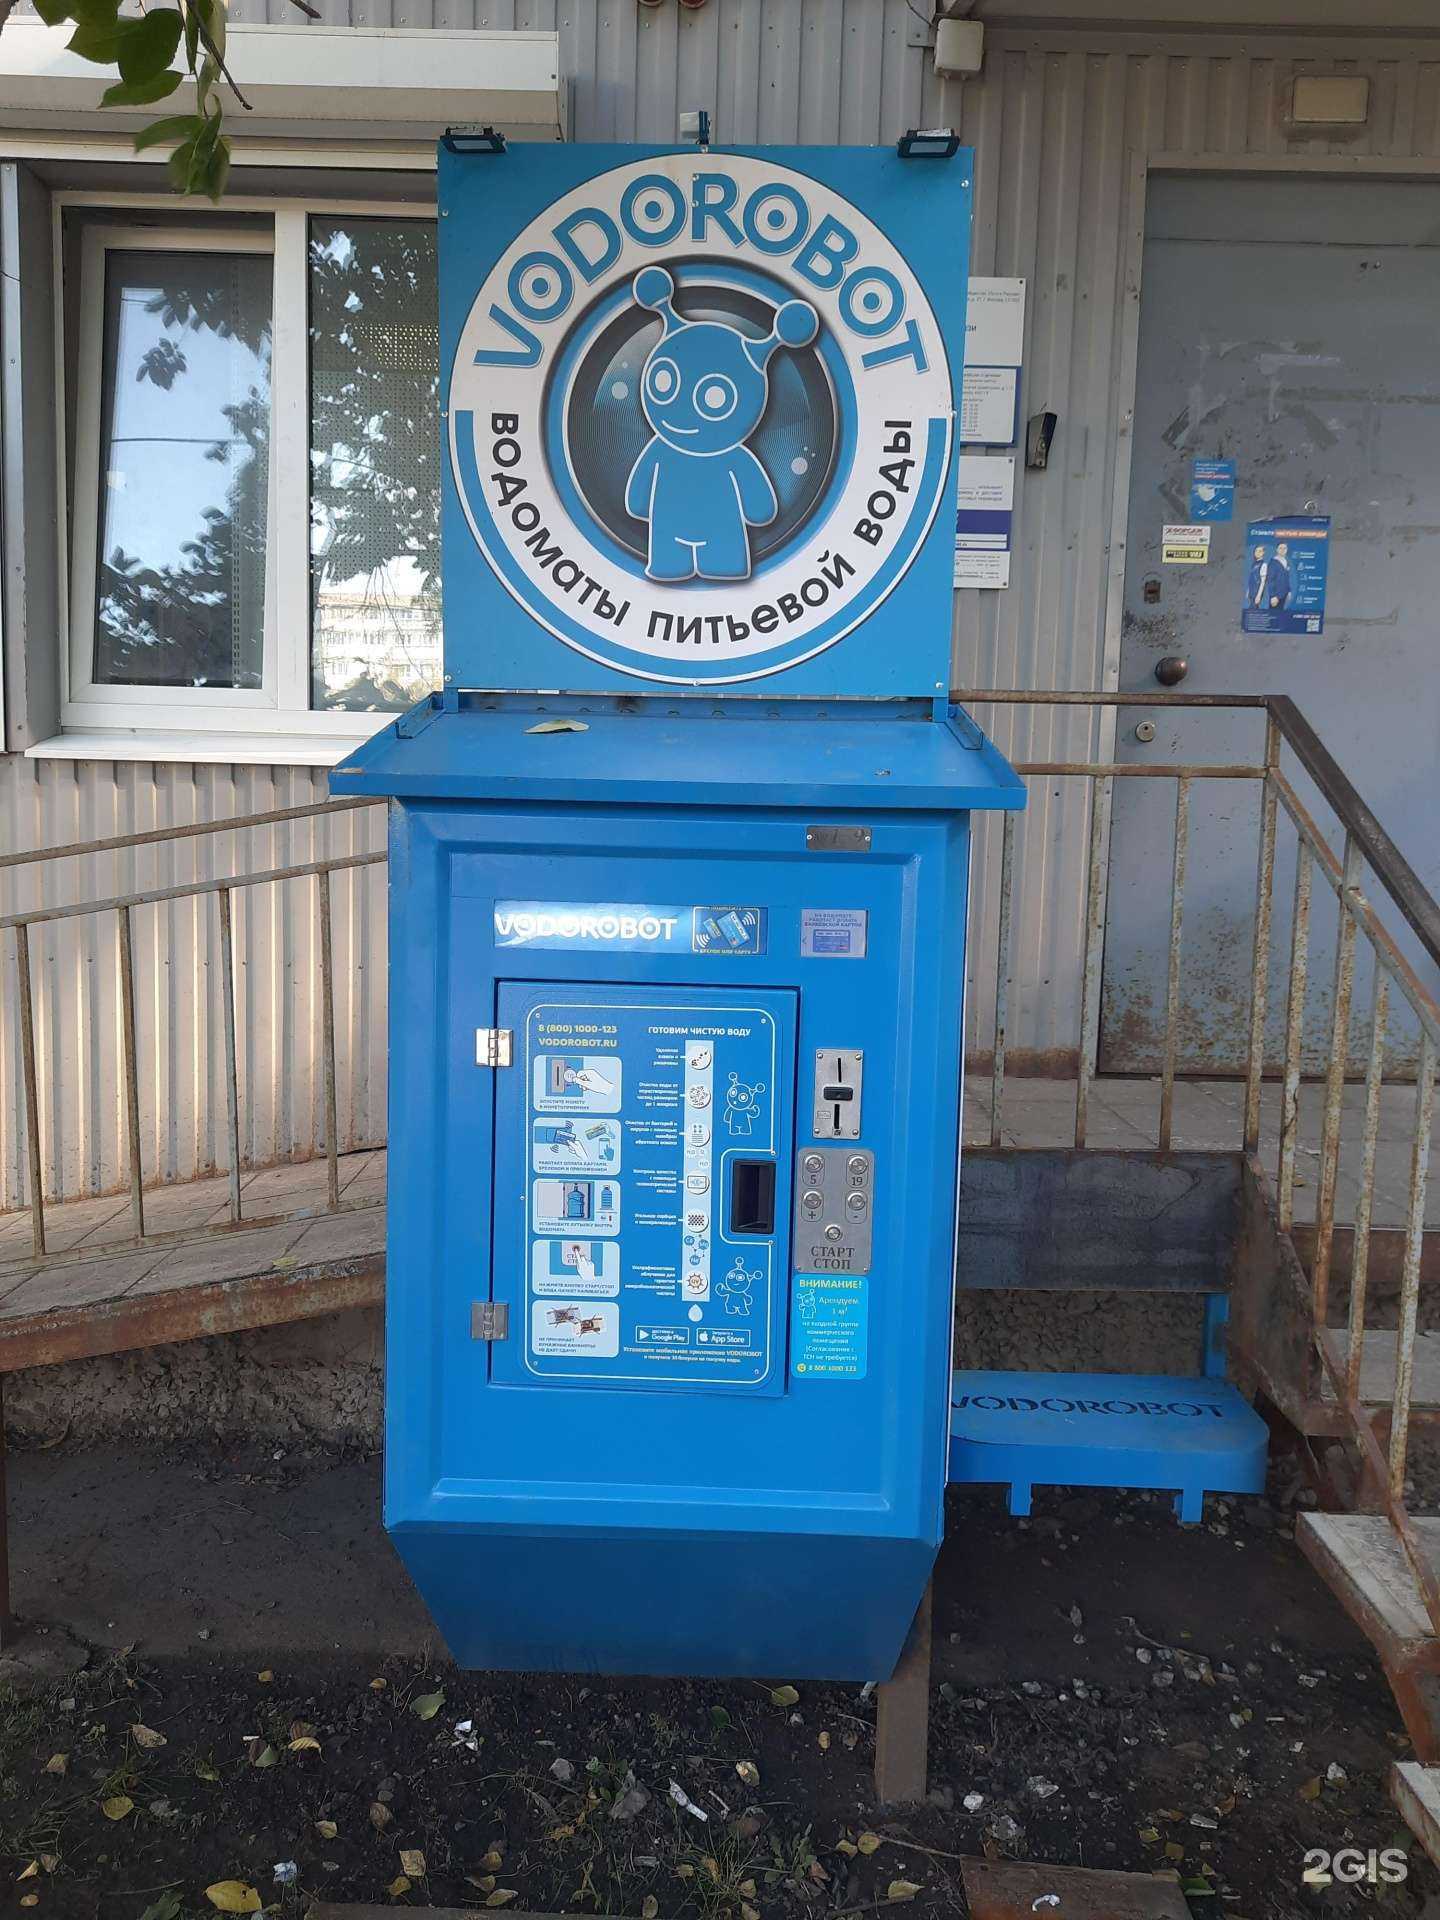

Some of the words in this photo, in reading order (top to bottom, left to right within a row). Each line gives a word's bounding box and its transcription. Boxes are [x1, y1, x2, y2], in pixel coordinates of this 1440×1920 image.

[473, 173, 930, 375] VODOROBOT
[494, 912, 678, 941] VODOROBOT
[546, 1025, 573, 1034] (800)
[574, 1025, 617, 1034] 1000-123
[648, 1026, 689, 1035] ГОТОВИМ
[690, 1027, 725, 1036] ЧИСТУЮ
[727, 1028, 751, 1037] ВОДУ
[538, 1038, 617, 1047] VODOROBOT.RU
[809, 1174, 817, 1185] 5
[851, 1176, 863, 1187] 19
[811, 1246, 855, 1258] СТАРТ
[813, 1258, 851, 1270] СТОП
[799, 1279, 862, 1289] ВНИМАНИЕ!
[711, 1335, 726, 1344] App
[727, 1335, 745, 1343] Store
[950, 1395, 1226, 1418] VODOROBOT
